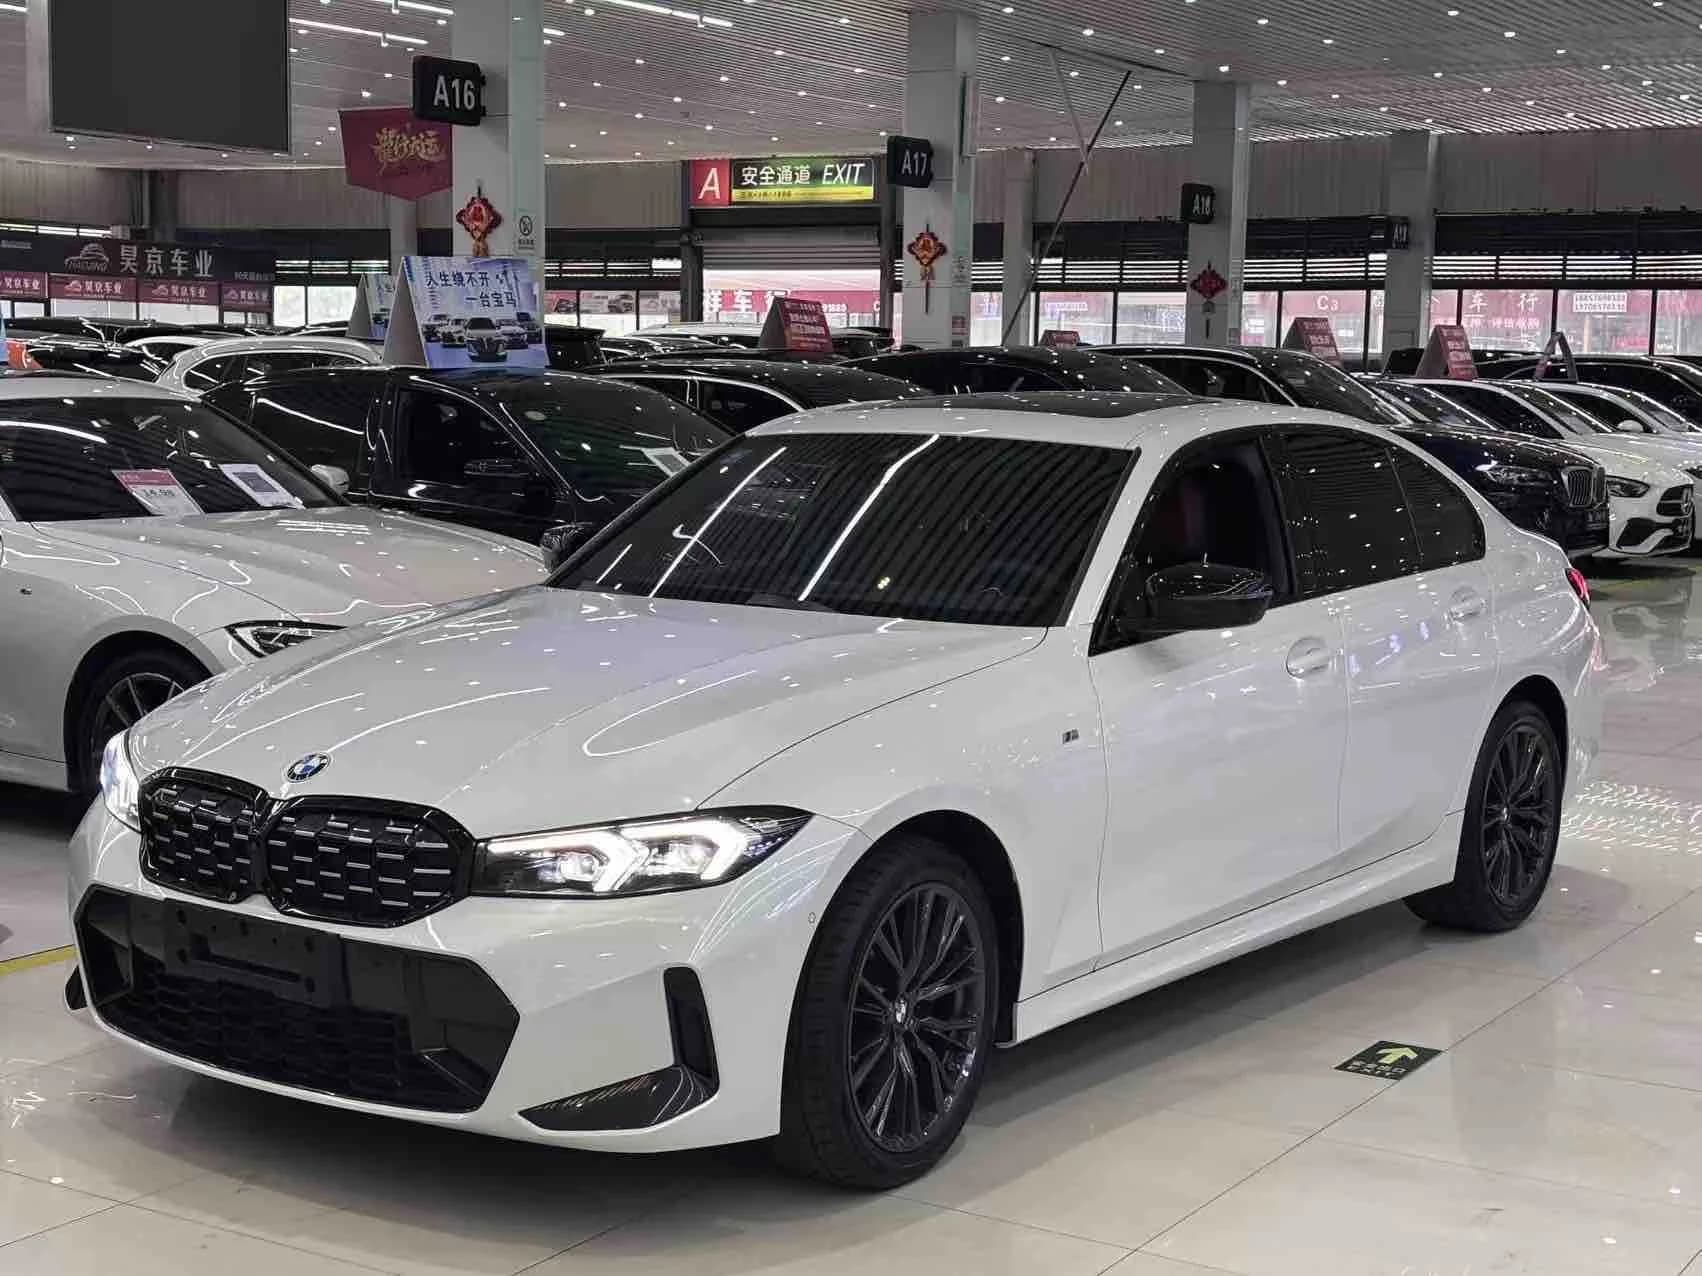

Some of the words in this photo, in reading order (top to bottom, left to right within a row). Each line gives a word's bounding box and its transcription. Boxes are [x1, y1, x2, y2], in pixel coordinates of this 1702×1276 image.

[433, 75, 476, 111] A16
[741, 165, 811, 186] 安全通道
[821, 163, 866, 185] EXIT
[902, 147, 928, 176] A17
[698, 167, 721, 200] A
[120, 244, 214, 278] 昊京车业
[465, 291, 517, 308] 一台宝马
